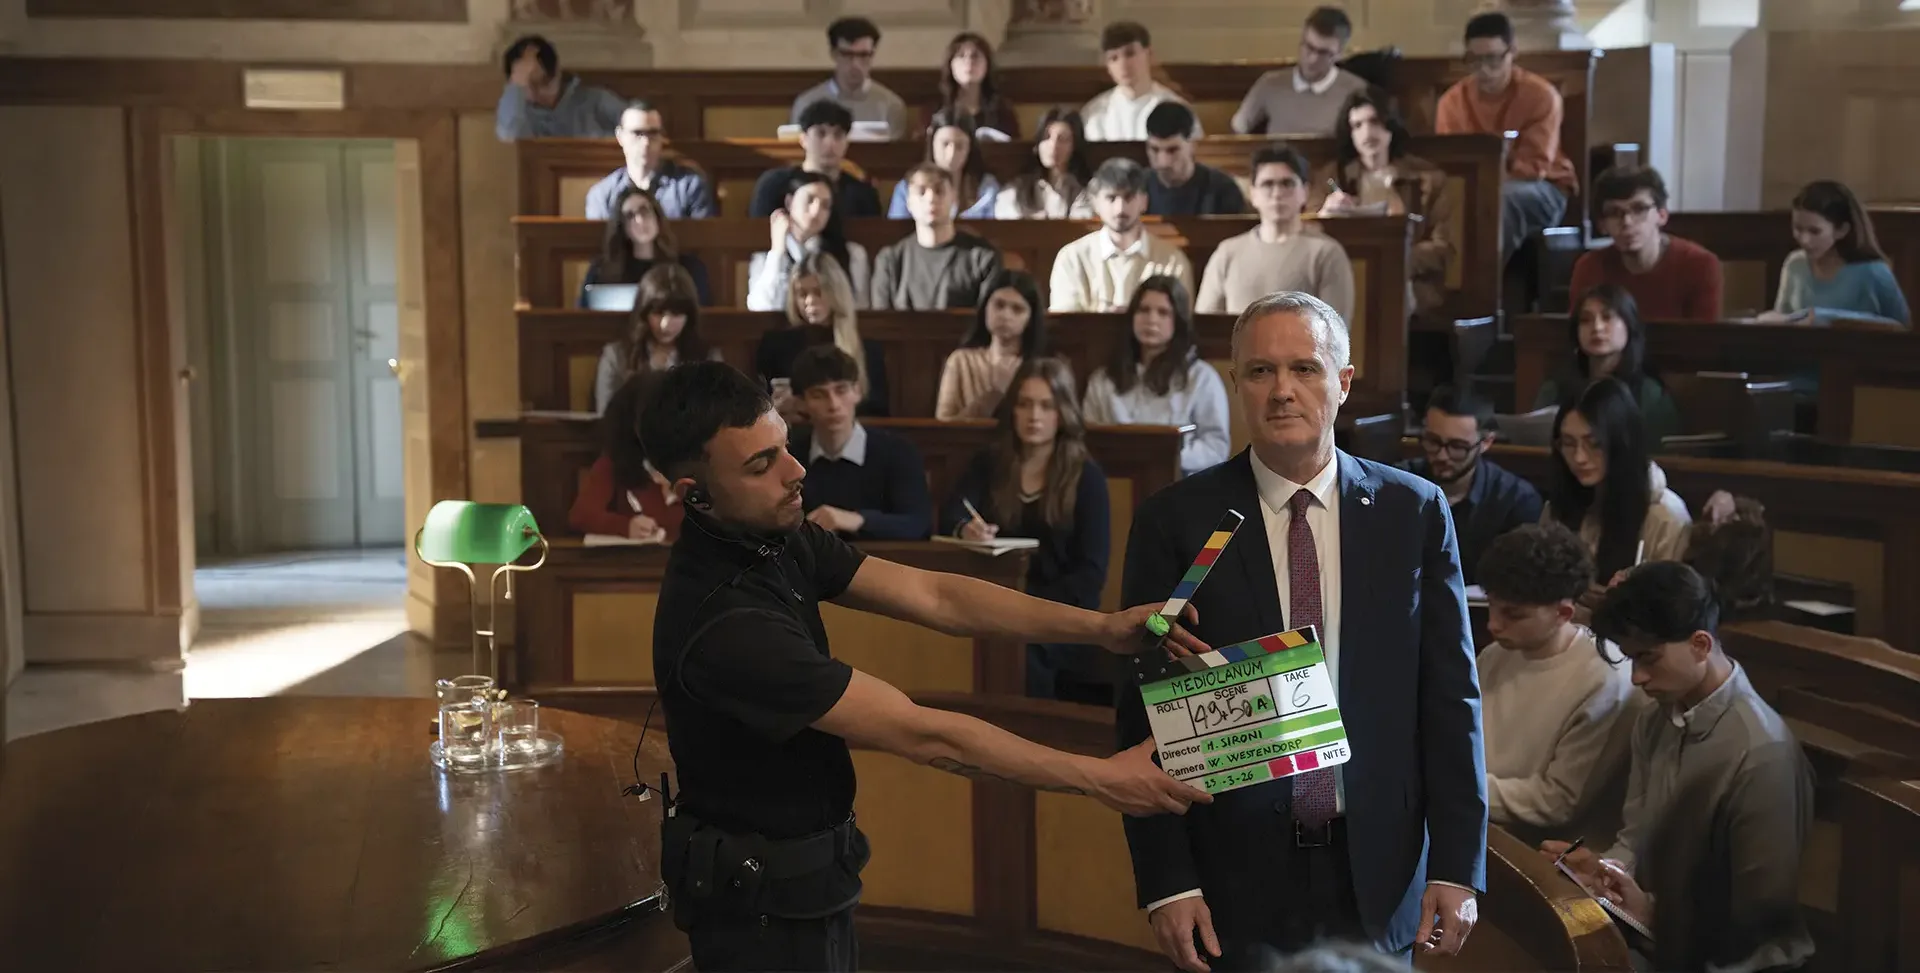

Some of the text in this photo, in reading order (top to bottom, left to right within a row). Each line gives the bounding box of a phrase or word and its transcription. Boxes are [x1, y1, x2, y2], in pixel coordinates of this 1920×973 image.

[1171, 660, 1264, 695] MEDIOLANUM
[1283, 669, 1310, 682] TAKE
[1214, 684, 1248, 700] SCENE
[1292, 681, 1311, 708] 6
[1156, 701, 1184, 714] ROLL
[1220, 729, 1262, 748] SIRONI
[1162, 744, 1200, 760] Director
[1208, 738, 1302, 768] W. WESTENDORP
[1322, 747, 1347, 760] NITE
[1167, 763, 1205, 778] Camera
